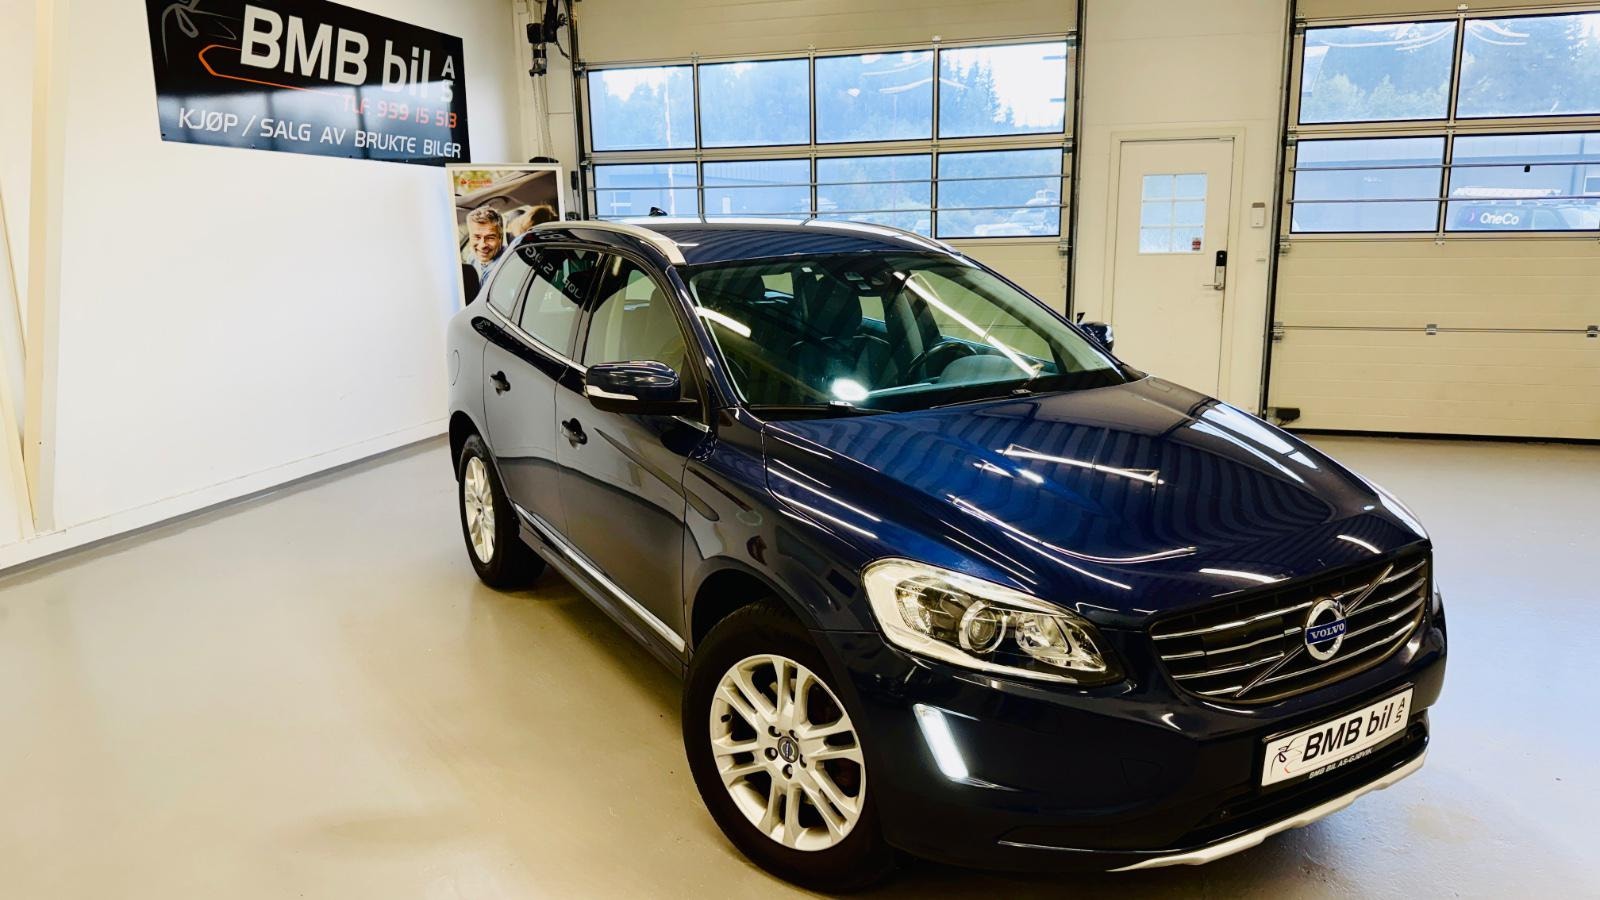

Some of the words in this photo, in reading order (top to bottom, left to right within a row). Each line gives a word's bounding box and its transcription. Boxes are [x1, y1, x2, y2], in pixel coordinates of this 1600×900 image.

[240, 4, 369, 86] BMB
[381, 39, 431, 98] bil
[178, 107, 239, 133] KJØP
[242, 114, 257, 137] /
[260, 118, 311, 142] SALG
[320, 126, 346, 145] AV
[354, 130, 416, 153] BRUKTE
[423, 139, 461, 159] BILER
[377, 100, 409, 121] 959
[416, 106, 430, 124] 15
[436, 111, 457, 128] 513
[1480, 212, 1520, 226] OneCo
[1311, 622, 1345, 639] VOLVO
[1302, 716, 1363, 762] BMB
[1366, 702, 1394, 738] bil
